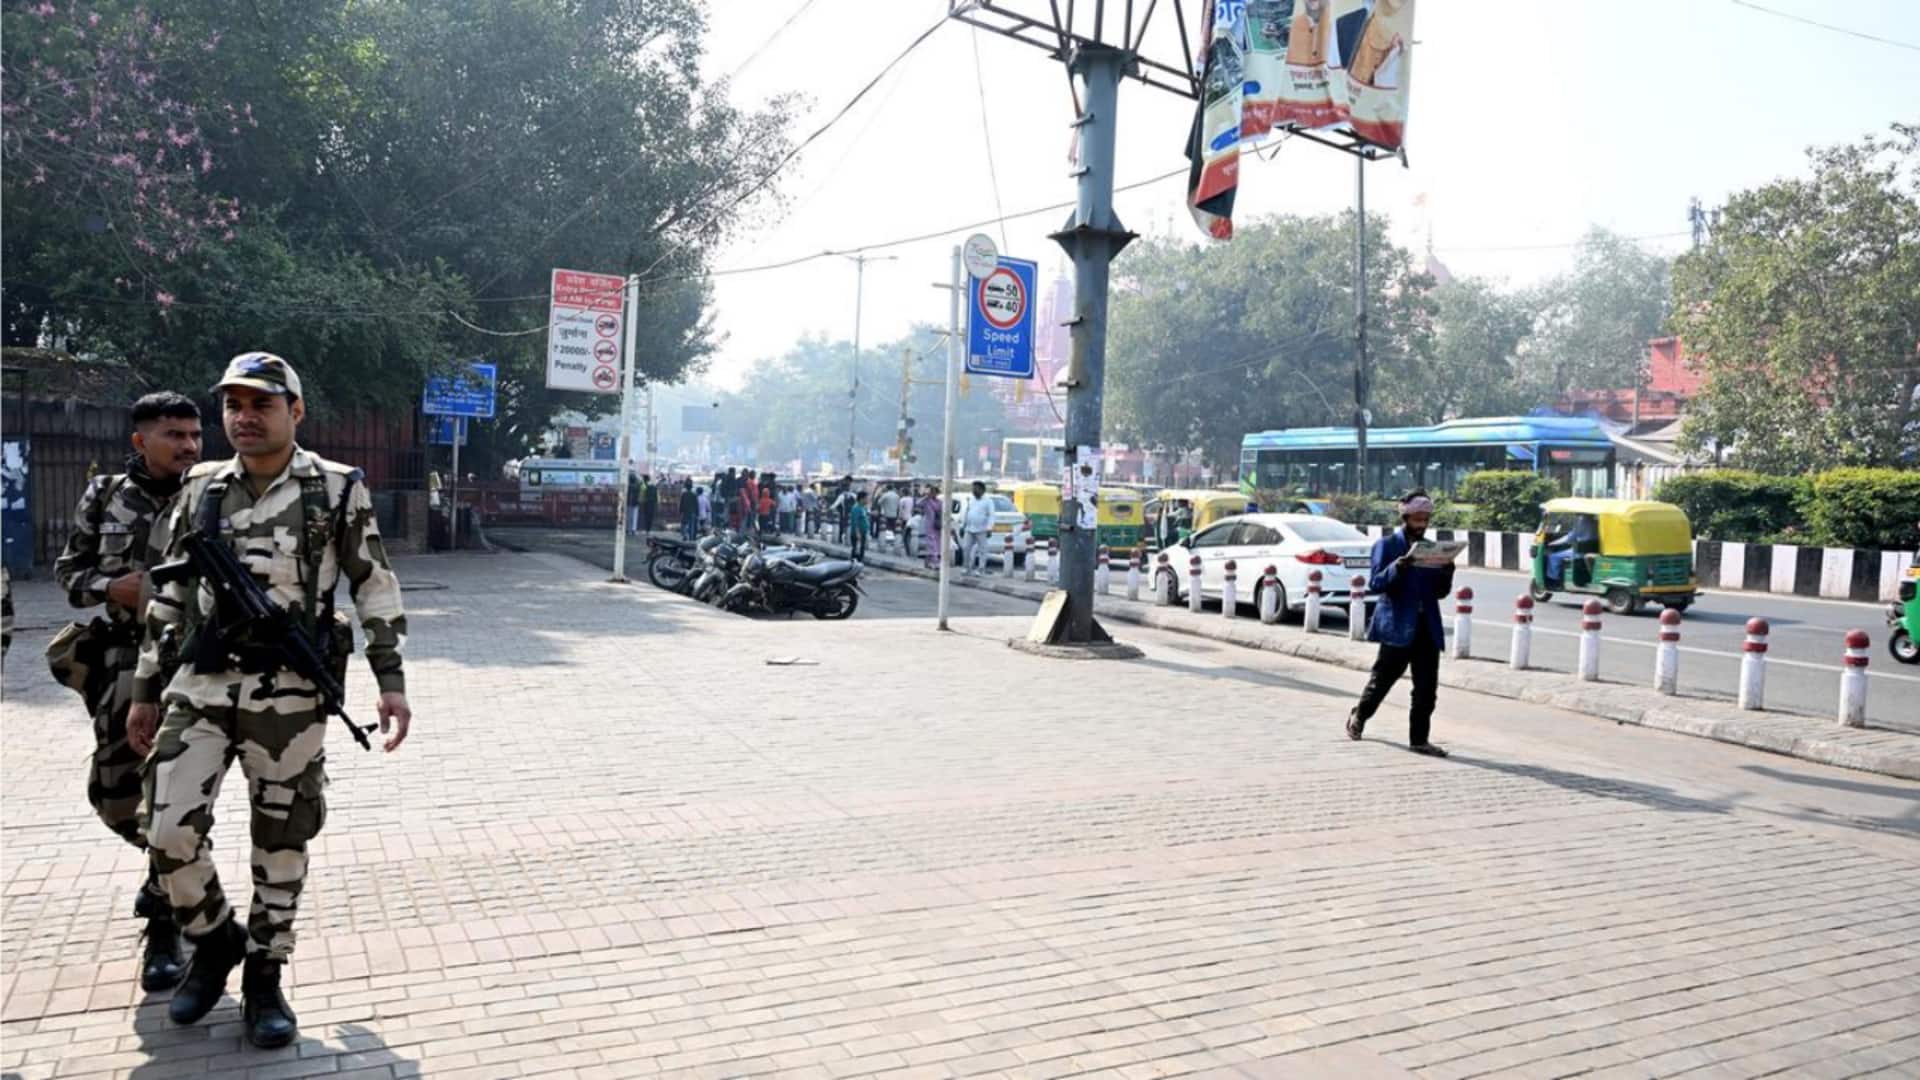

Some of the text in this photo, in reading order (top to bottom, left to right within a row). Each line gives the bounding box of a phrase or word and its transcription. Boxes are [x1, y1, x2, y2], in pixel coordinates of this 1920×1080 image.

[1005, 284, 1018, 298] 50
[1005, 301, 1018, 313] 40
[983, 328, 1020, 345] Speed
[987, 343, 1015, 360] Limit
[555, 359, 587, 374] Penalty
